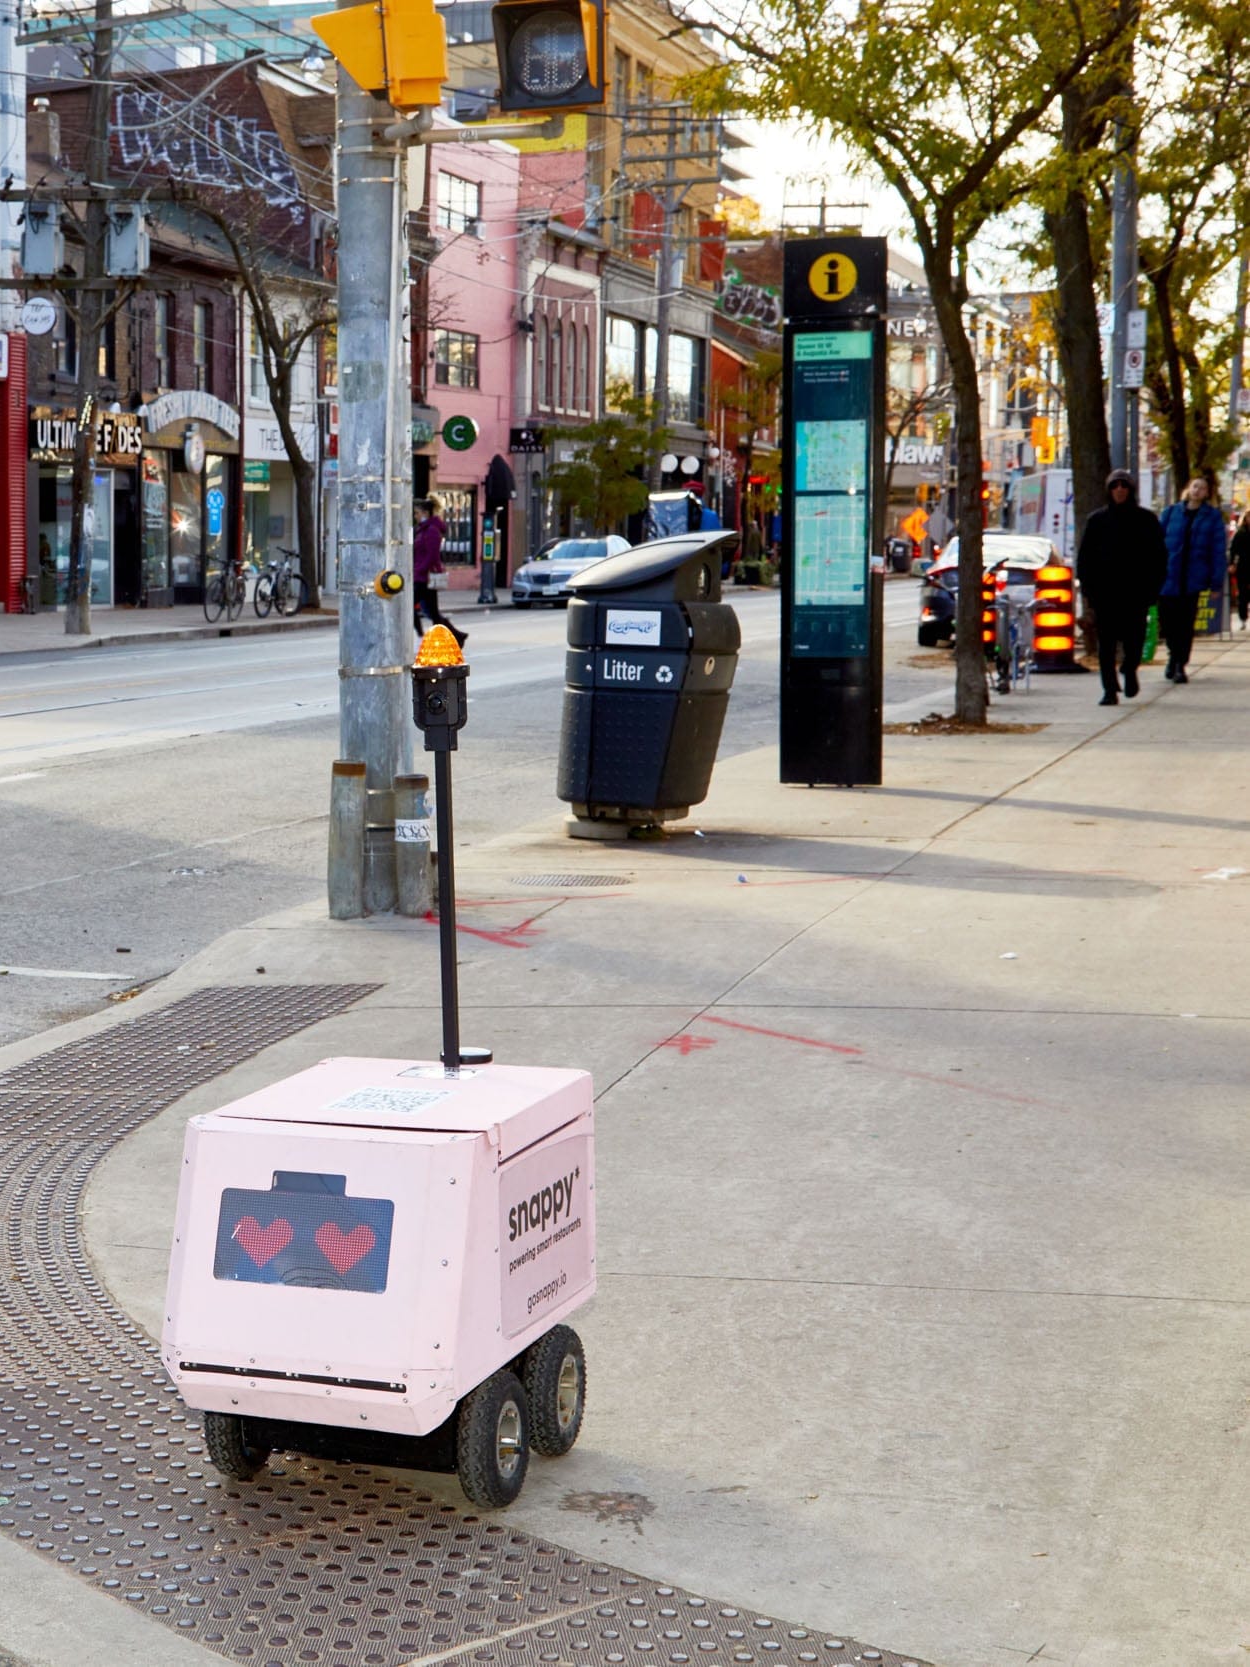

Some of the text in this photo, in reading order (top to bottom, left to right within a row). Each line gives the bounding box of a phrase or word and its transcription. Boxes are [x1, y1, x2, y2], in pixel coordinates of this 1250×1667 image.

[452, 424, 465, 442] C
[603, 658, 645, 681] Litter
[509, 1216, 582, 1276] powering smart restaurants
[527, 1269, 568, 1315] gosnappy.io
